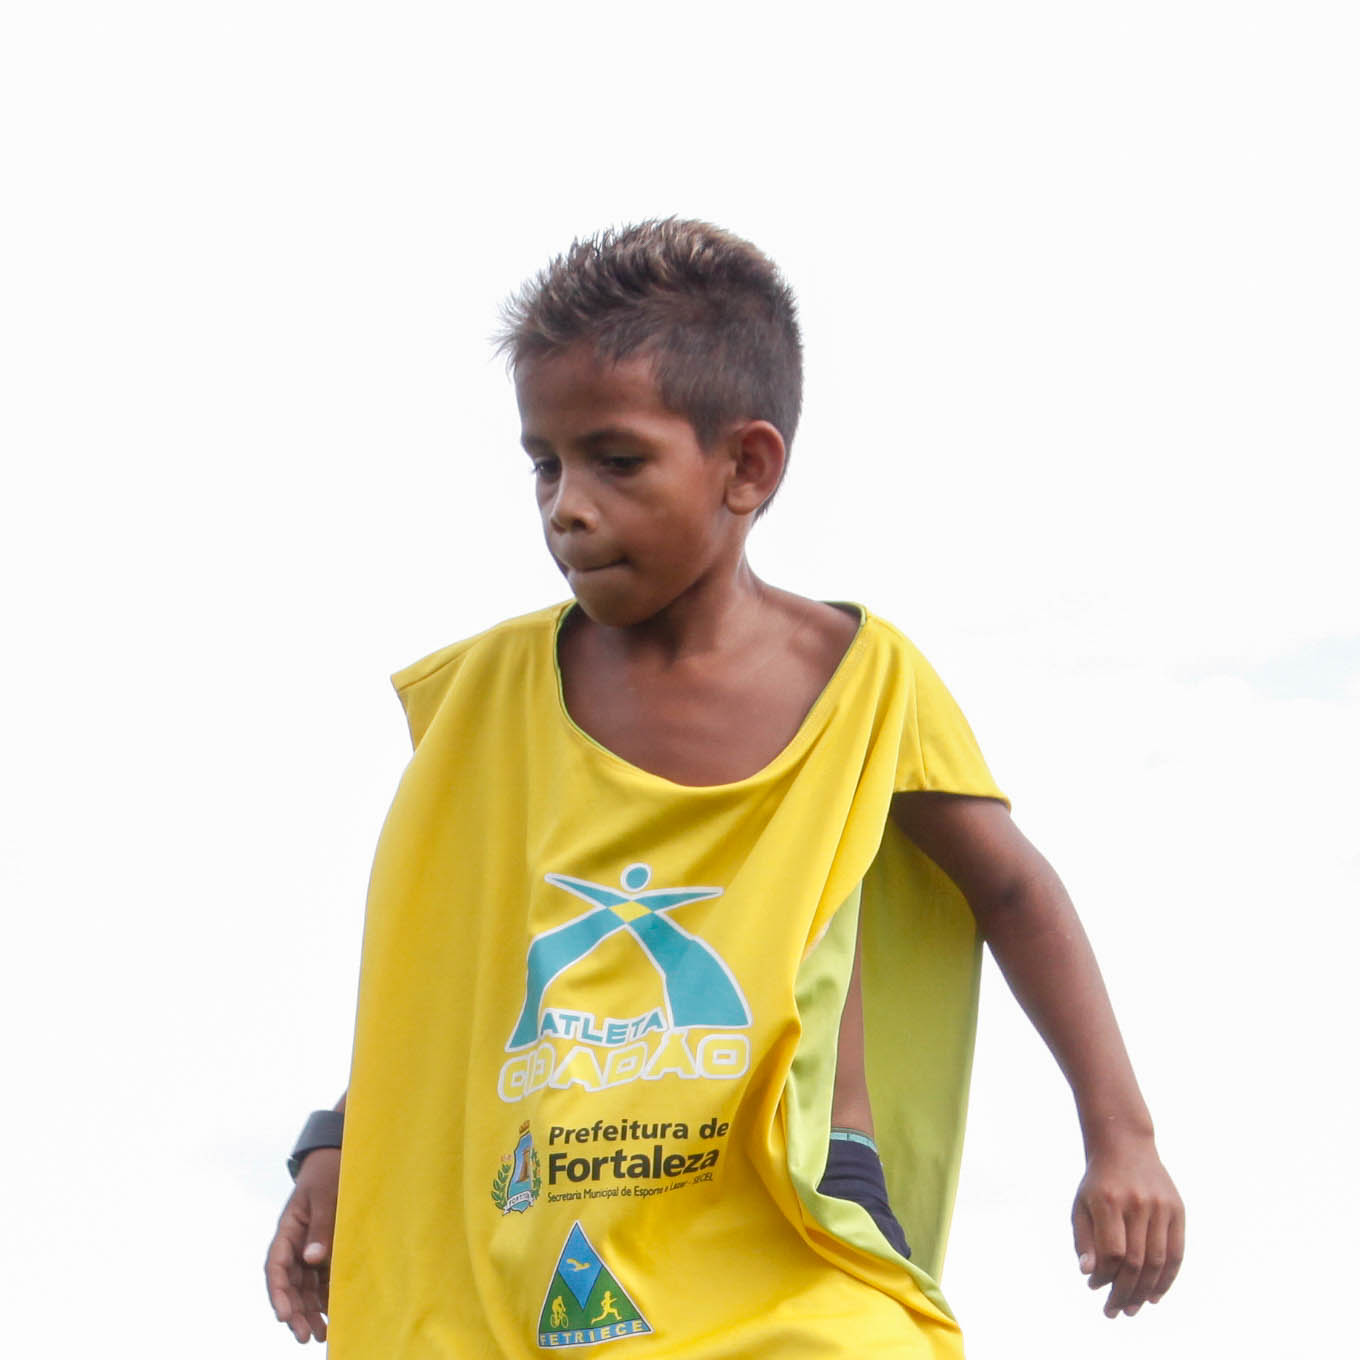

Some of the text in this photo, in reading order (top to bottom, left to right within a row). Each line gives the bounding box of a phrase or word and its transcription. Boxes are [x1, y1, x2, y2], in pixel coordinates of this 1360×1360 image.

[540, 1009, 665, 1045] ATLETA
[548, 1117, 730, 1146] Prefeitura de
[547, 1144, 720, 1185] Fortaleza
[547, 1190, 582, 1203] Secretaria
[583, 1187, 619, 1200] Municipal
[620, 1185, 633, 1197] de
[540, 1319, 644, 1347] FETRIECE
